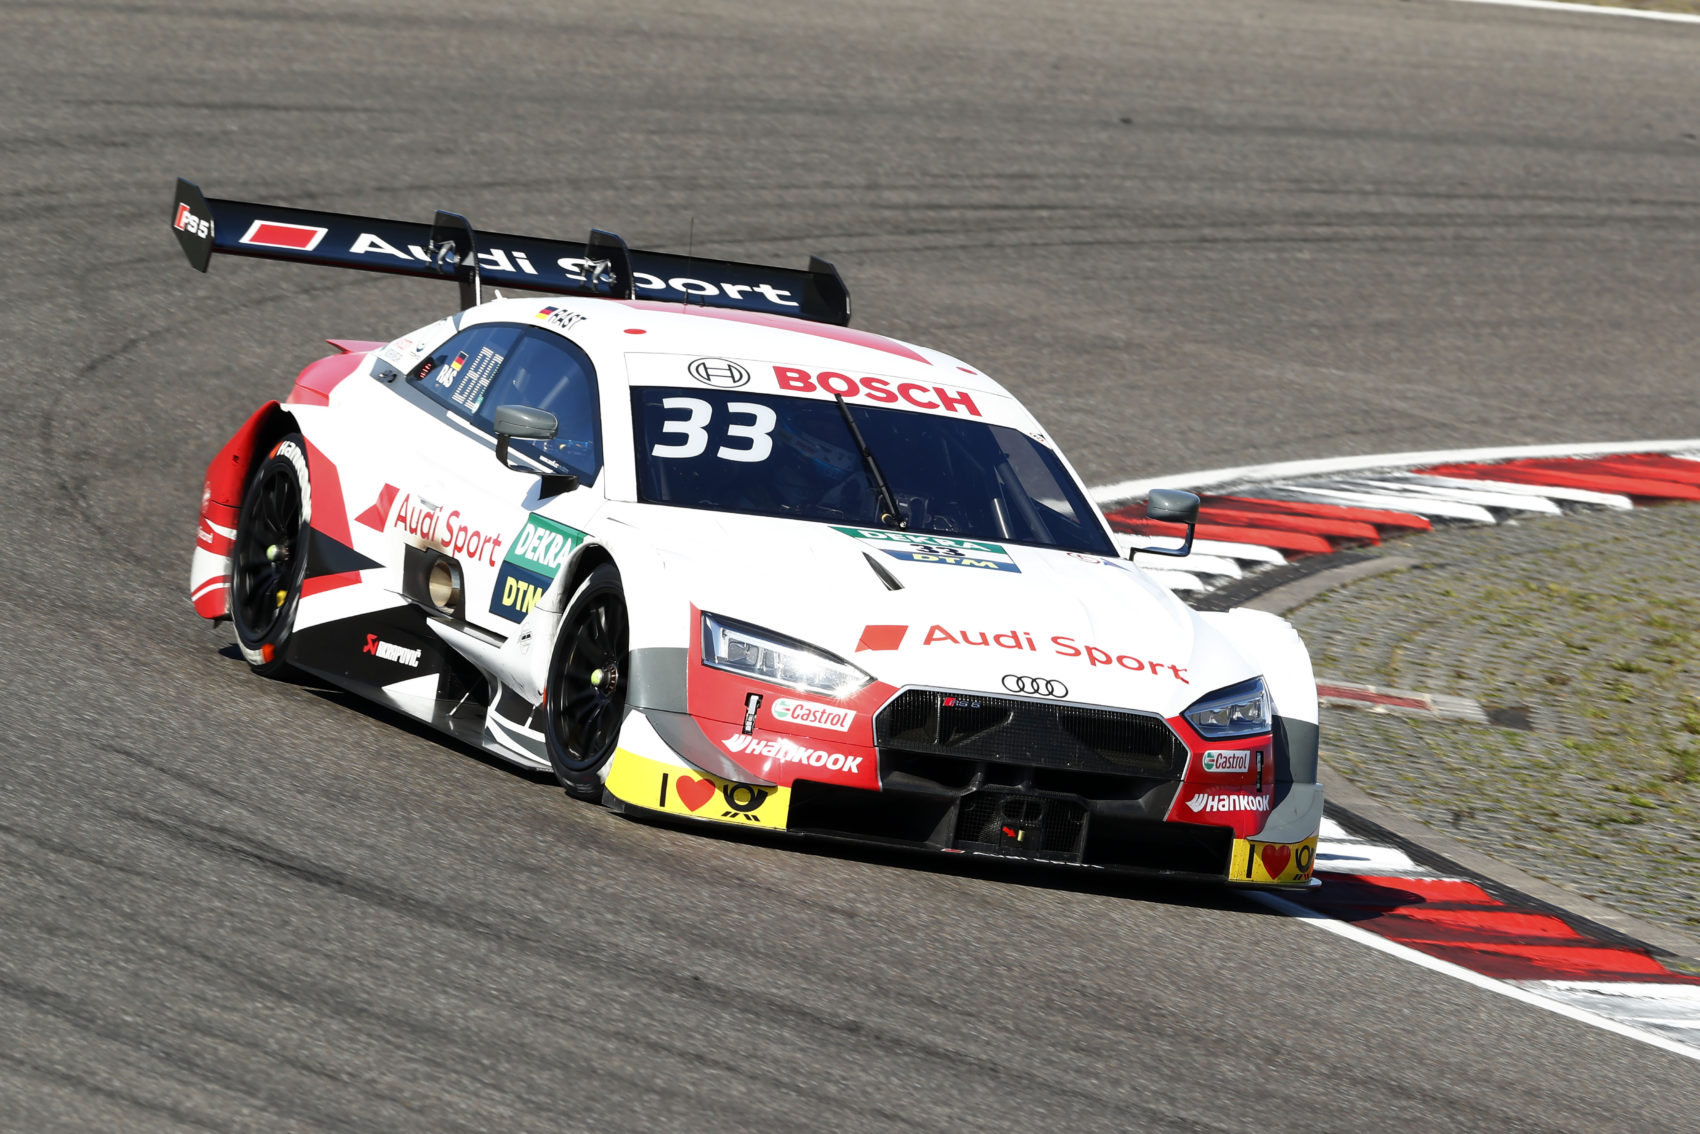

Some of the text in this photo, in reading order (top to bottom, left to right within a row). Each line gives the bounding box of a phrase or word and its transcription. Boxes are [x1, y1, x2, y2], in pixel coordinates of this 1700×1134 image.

[548, 308, 588, 332] RAST
[771, 364, 984, 418] BOSCH
[651, 396, 778, 463] 33
[394, 492, 503, 568] Audi Sport
[857, 528, 992, 552] DEKRA
[909, 542, 967, 558] 33
[911, 552, 1000, 569] DTM
[501, 575, 544, 614] DTM
[922, 623, 1191, 686] Audi Sport
[791, 702, 850, 730] Castrol
[1214, 751, 1249, 771] Castrol
